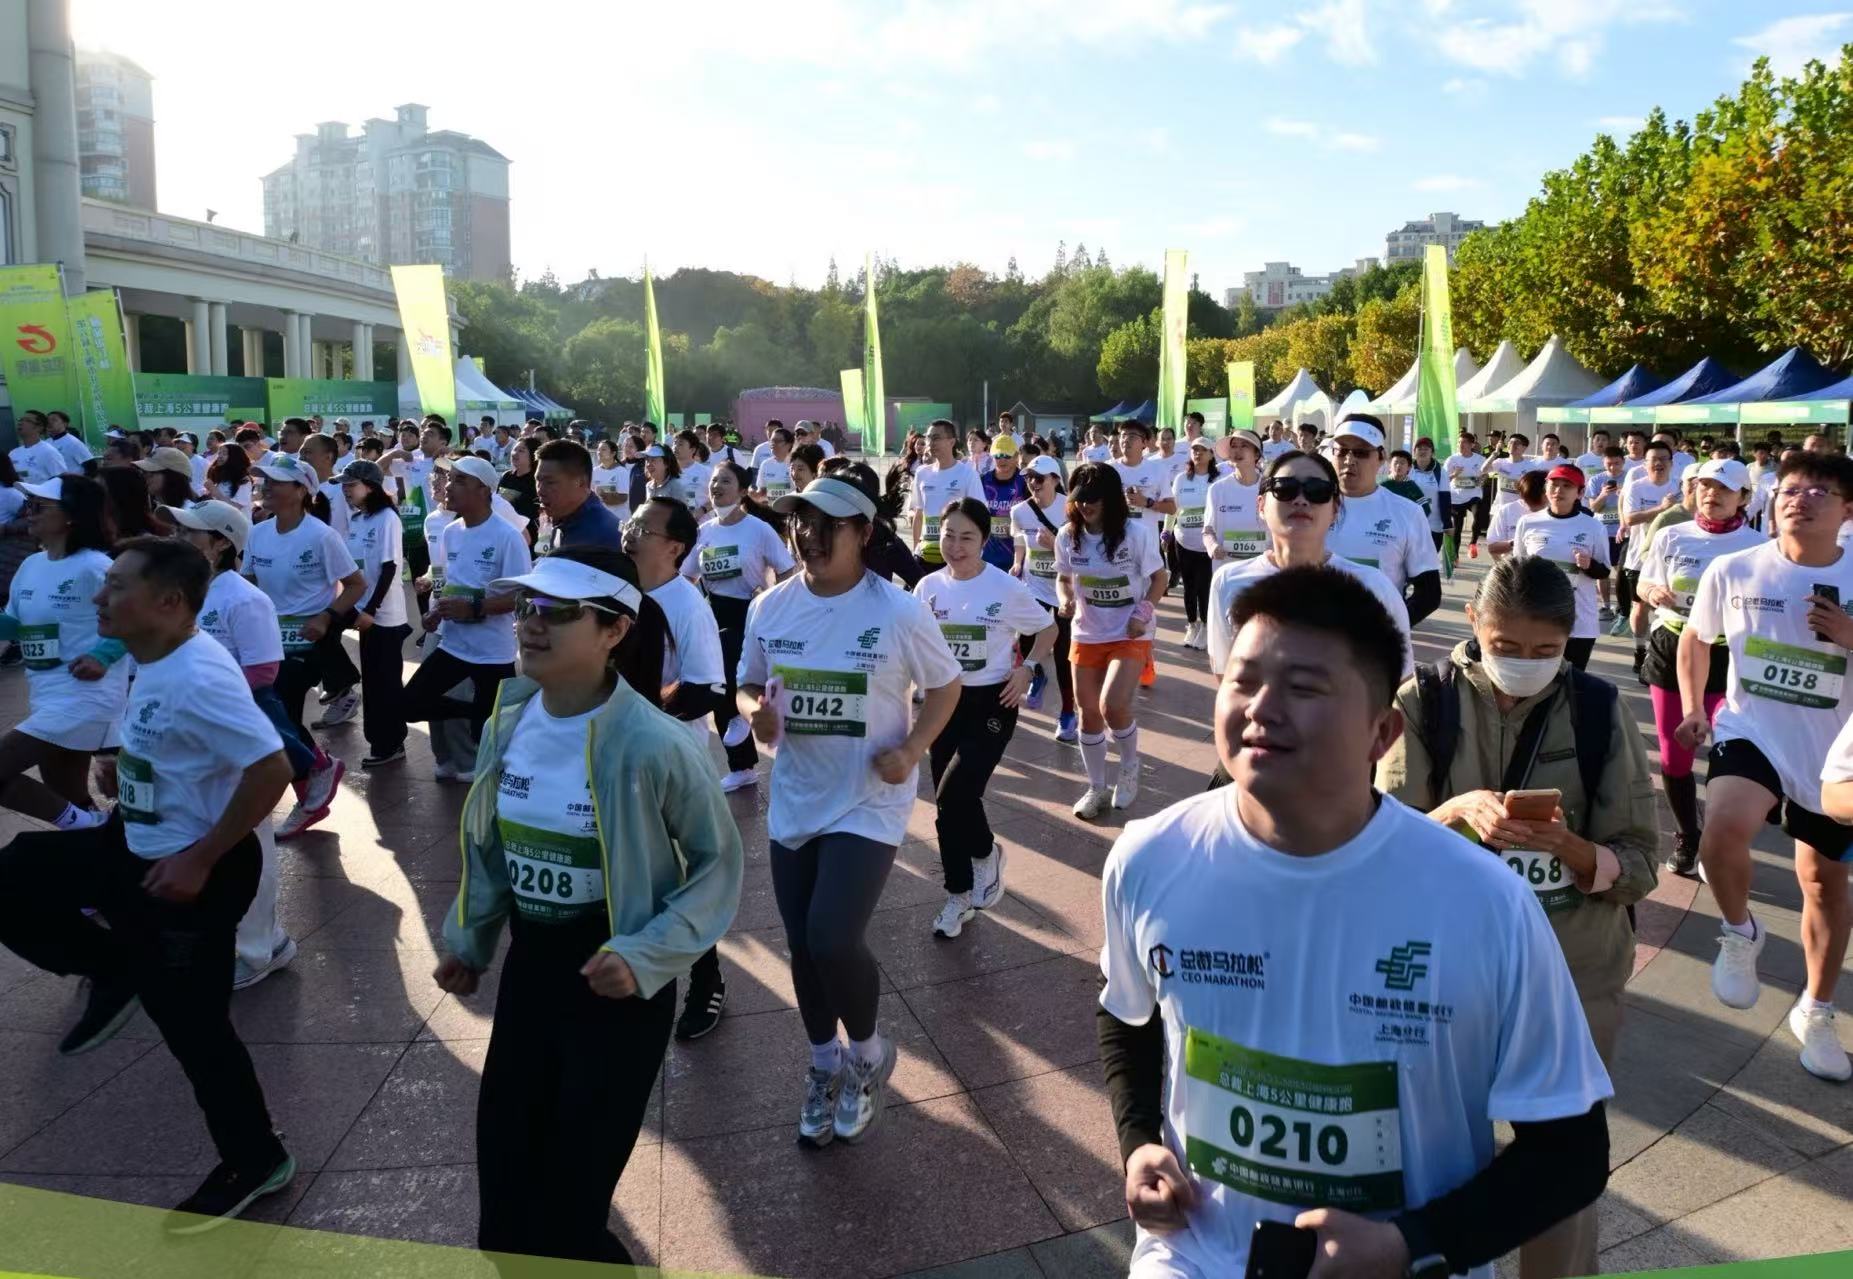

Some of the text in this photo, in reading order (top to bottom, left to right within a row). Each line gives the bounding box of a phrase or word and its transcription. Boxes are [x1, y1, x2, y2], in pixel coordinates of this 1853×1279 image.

[1233, 542, 1256, 551] 0166
[704, 559, 730, 572] 0202
[1093, 589, 1120, 600] 0130
[1763, 664, 1818, 690] 0138
[791, 695, 843, 717] 0142
[509, 859, 573, 899] 0208
[1181, 949, 1264, 977] 总裁马拉松
[1181, 971, 1265, 990] CEO MARATHON
[1219, 1072, 1352, 1112] 总裁上海5公里健康跑
[1230, 1105, 1348, 1166] 0210
